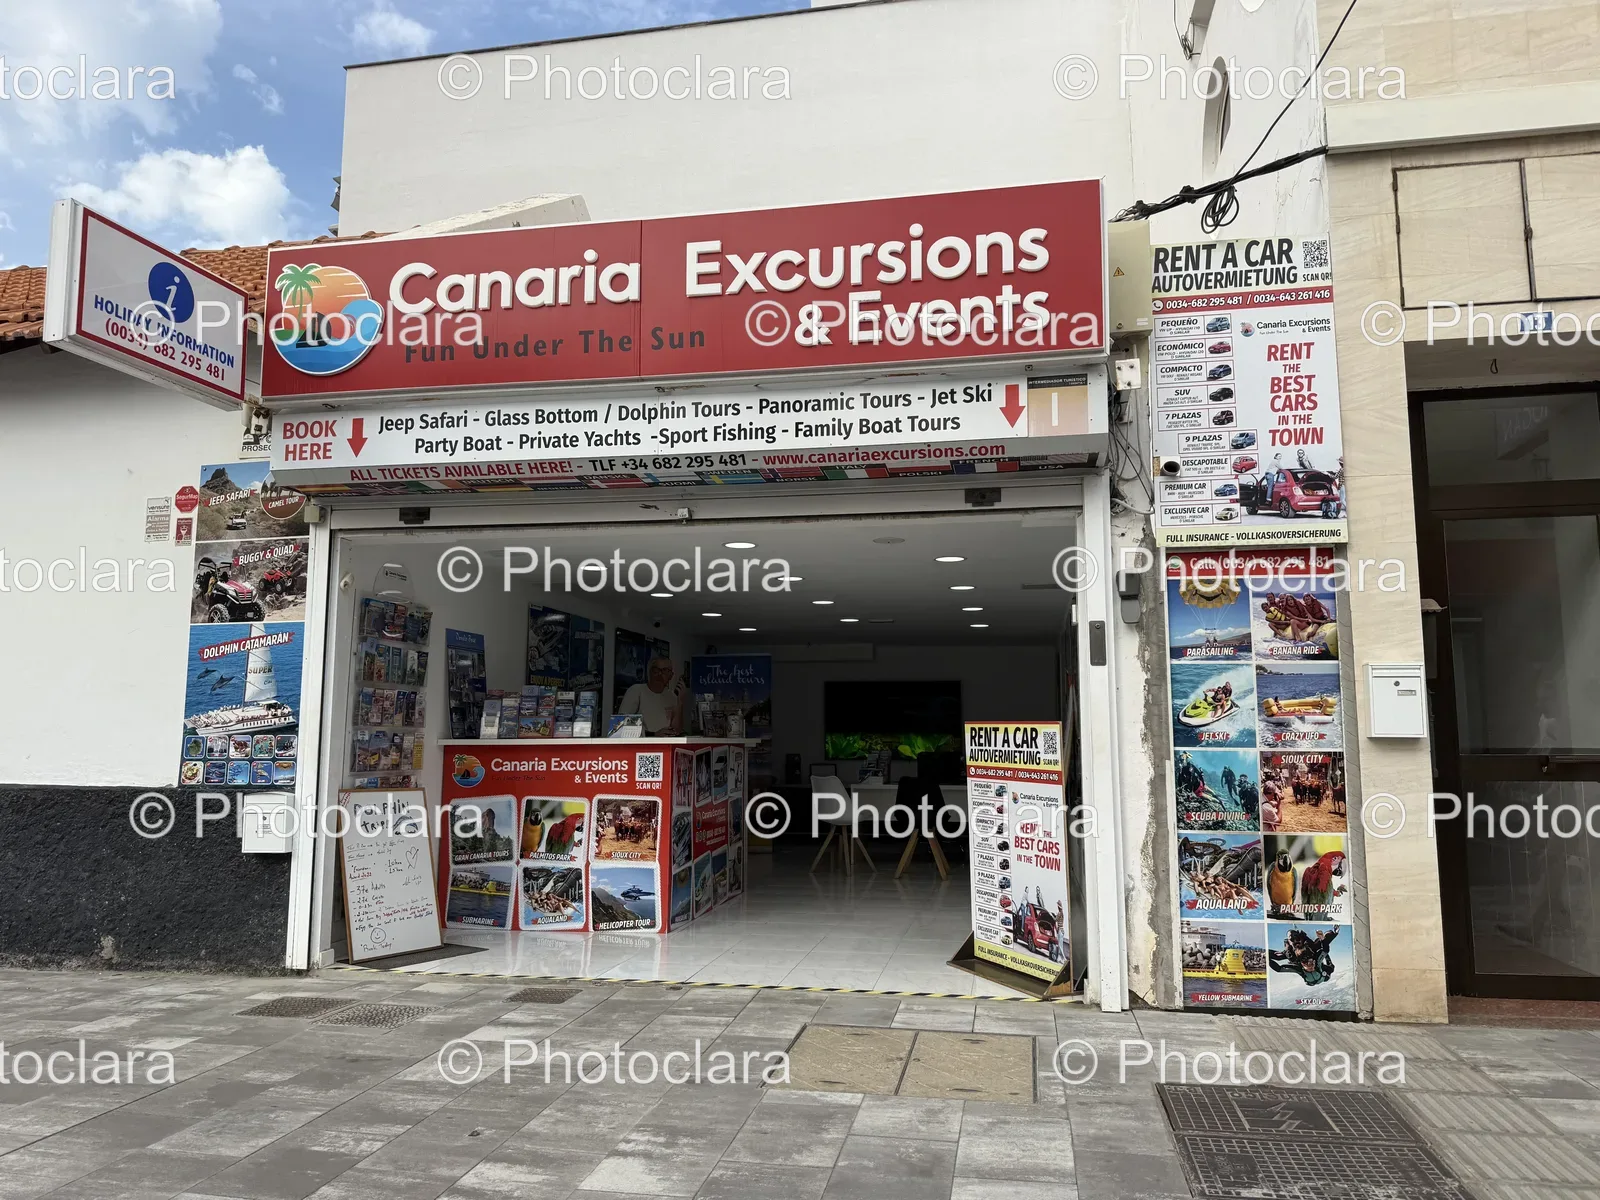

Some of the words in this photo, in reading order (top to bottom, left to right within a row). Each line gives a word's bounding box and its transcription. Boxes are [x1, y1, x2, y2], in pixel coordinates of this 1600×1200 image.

[1154, 243, 1217, 273] RENT
[1221, 242, 1239, 269] A
[1244, 238, 1294, 267] CAR
[389, 248, 640, 314] Canaria
[685, 223, 1050, 298] Excursions
[1151, 266, 1298, 293] AUTOVERMIETUNG
[1302, 274, 1319, 282] SCAN
[1166, 299, 1208, 309] 0034-682
[1209, 297, 1225, 306] 295
[1227, 295, 1243, 305] 481
[1253, 292, 1296, 303] 0034-643
[1297, 291, 1313, 300] 261
[1315, 289, 1330, 298] 416
[794, 304, 833, 347] &
[848, 284, 1051, 346] Events
[1161, 318, 1198, 327] PEQUEÑO
[1256, 320, 1287, 330] Canaria
[1288, 317, 1331, 327] Excursions
[94, 295, 152, 331] HOLIDAY
[157, 322, 235, 369] INFORMATION
[1307, 325, 1331, 333] Events
[472, 335, 563, 358] Under
[579, 329, 632, 353] The
[651, 326, 706, 350] Sun
[1157, 342, 1204, 352] ECONÓMICO
[105, 318, 149, 351] (0034)
[154, 344, 176, 361] 682
[181, 351, 202, 371] 295
[206, 363, 225, 381] 481
[1267, 342, 1315, 362] RENT
[1160, 364, 1203, 374] COMPACTO
[1282, 364, 1301, 373] THE
[1270, 374, 1316, 394] BEST
[1174, 388, 1191, 397] SUV
[1269, 393, 1318, 412] CARS
[378, 414, 415, 436] Jeep
[418, 409, 469, 430] Safari
[484, 409, 530, 427] Glass
[535, 405, 599, 425] Bottom
[618, 401, 687, 425] Dolphin
[692, 400, 741, 418] Tours
[758, 391, 855, 415] Panoramic
[860, 391, 912, 409] Tours
[929, 387, 957, 409] Jet
[962, 383, 993, 404] Ski
[1172, 411, 1202, 420] PLAZAS
[1277, 415, 1290, 426] IN
[1292, 413, 1313, 425] THE
[282, 418, 337, 440] BOOK
[414, 435, 458, 457] Party
[463, 433, 503, 452] Boat
[518, 431, 580, 451] Private
[584, 429, 641, 449] Yachts
[712, 421, 777, 444] Fishing
[794, 418, 854, 443] Family
[858, 416, 902, 434] Boat
[907, 414, 961, 432] Tours
[1192, 434, 1223, 443] PLAZAS
[1269, 427, 1324, 447] TOWN
[284, 441, 333, 463] HERE
[350, 469, 377, 482] ALL
[378, 466, 441, 481] TICKETS
[444, 463, 528, 478] AVAILABLE
[529, 459, 575, 475] HERE!
[589, 459, 617, 472] TLF
[621, 458, 648, 471] +34
[652, 456, 682, 470] 682
[686, 454, 714, 468] 295
[718, 452, 746, 466] 481
[763, 441, 1006, 467] www.canariaexcursions.com
[1182, 457, 1229, 467] DESCAPOTABLE
[1164, 483, 1195, 491] PREMIUM
[1195, 482, 1207, 490] CAR
[208, 495, 225, 507] JEEP
[226, 488, 250, 503] SAFARI
[268, 497, 285, 509] CAMEL
[1163, 507, 1198, 515] EXCLUSIVE
[1197, 506, 1210, 514] CAR
[1166, 533, 1185, 543] FULL
[1186, 532, 1229, 542] INSURANCE
[1236, 528, 1341, 541] VOLLKASKOVERSICHERUNG
[238, 552, 265, 566] BUGGY
[265, 549, 272, 559] &
[272, 544, 294, 558] QUAD
[203, 641, 239, 659] DOLPHIN
[1187, 648, 1234, 656] PARASAILING
[1272, 647, 1302, 655] BANANA
[1302, 645, 1319, 654] RIDE
[248, 665, 273, 675] SUPER
[970, 727, 1000, 748] RENT
[1002, 727, 1010, 748] A
[1013, 727, 1039, 749] CAR
[1202, 732, 1215, 741] JET
[1215, 732, 1227, 741] SKI
[1281, 732, 1304, 741] CRAZY
[1305, 732, 1319, 740] UFO
[969, 748, 1041, 765] AUTOVERMIETUNG
[1281, 754, 1305, 764] SIOUX
[1306, 754, 1323, 764] CITY
[490, 757, 547, 772] Canaria
[551, 757, 629, 771] Excursions
[574, 775, 582, 784] &
[585, 772, 628, 784] Events
[636, 782, 649, 790] SCAN
[651, 782, 662, 790] QR!
[1191, 811, 1217, 821] SCUBA
[1217, 811, 1246, 821] DIVING
[1014, 836, 1036, 851] BEST
[1036, 838, 1060, 855] CARS
[454, 853, 468, 861] GRAN
[469, 851, 492, 860] CANARIA
[493, 850, 509, 858] TOURS
[529, 852, 555, 861] PALMITOS
[556, 853, 571, 861] PARK
[611, 851, 628, 859] SIOUX
[628, 851, 642, 859] CITY
[1016, 853, 1023, 862] IN
[1023, 855, 1033, 864] THE
[1034, 854, 1061, 872] TOWN
[1195, 899, 1248, 910] AQUALAND
[1280, 904, 1318, 913] PALMITOS
[1319, 903, 1342, 913] PARK
[462, 917, 495, 925] SUBMARINE
[537, 914, 568, 924] AQUALAND
[599, 920, 633, 930] HELICOPTER
[634, 918, 651, 927] TOUR
[1198, 994, 1220, 1002] YELLOW
[1221, 994, 1253, 1002] SUBMARINE
